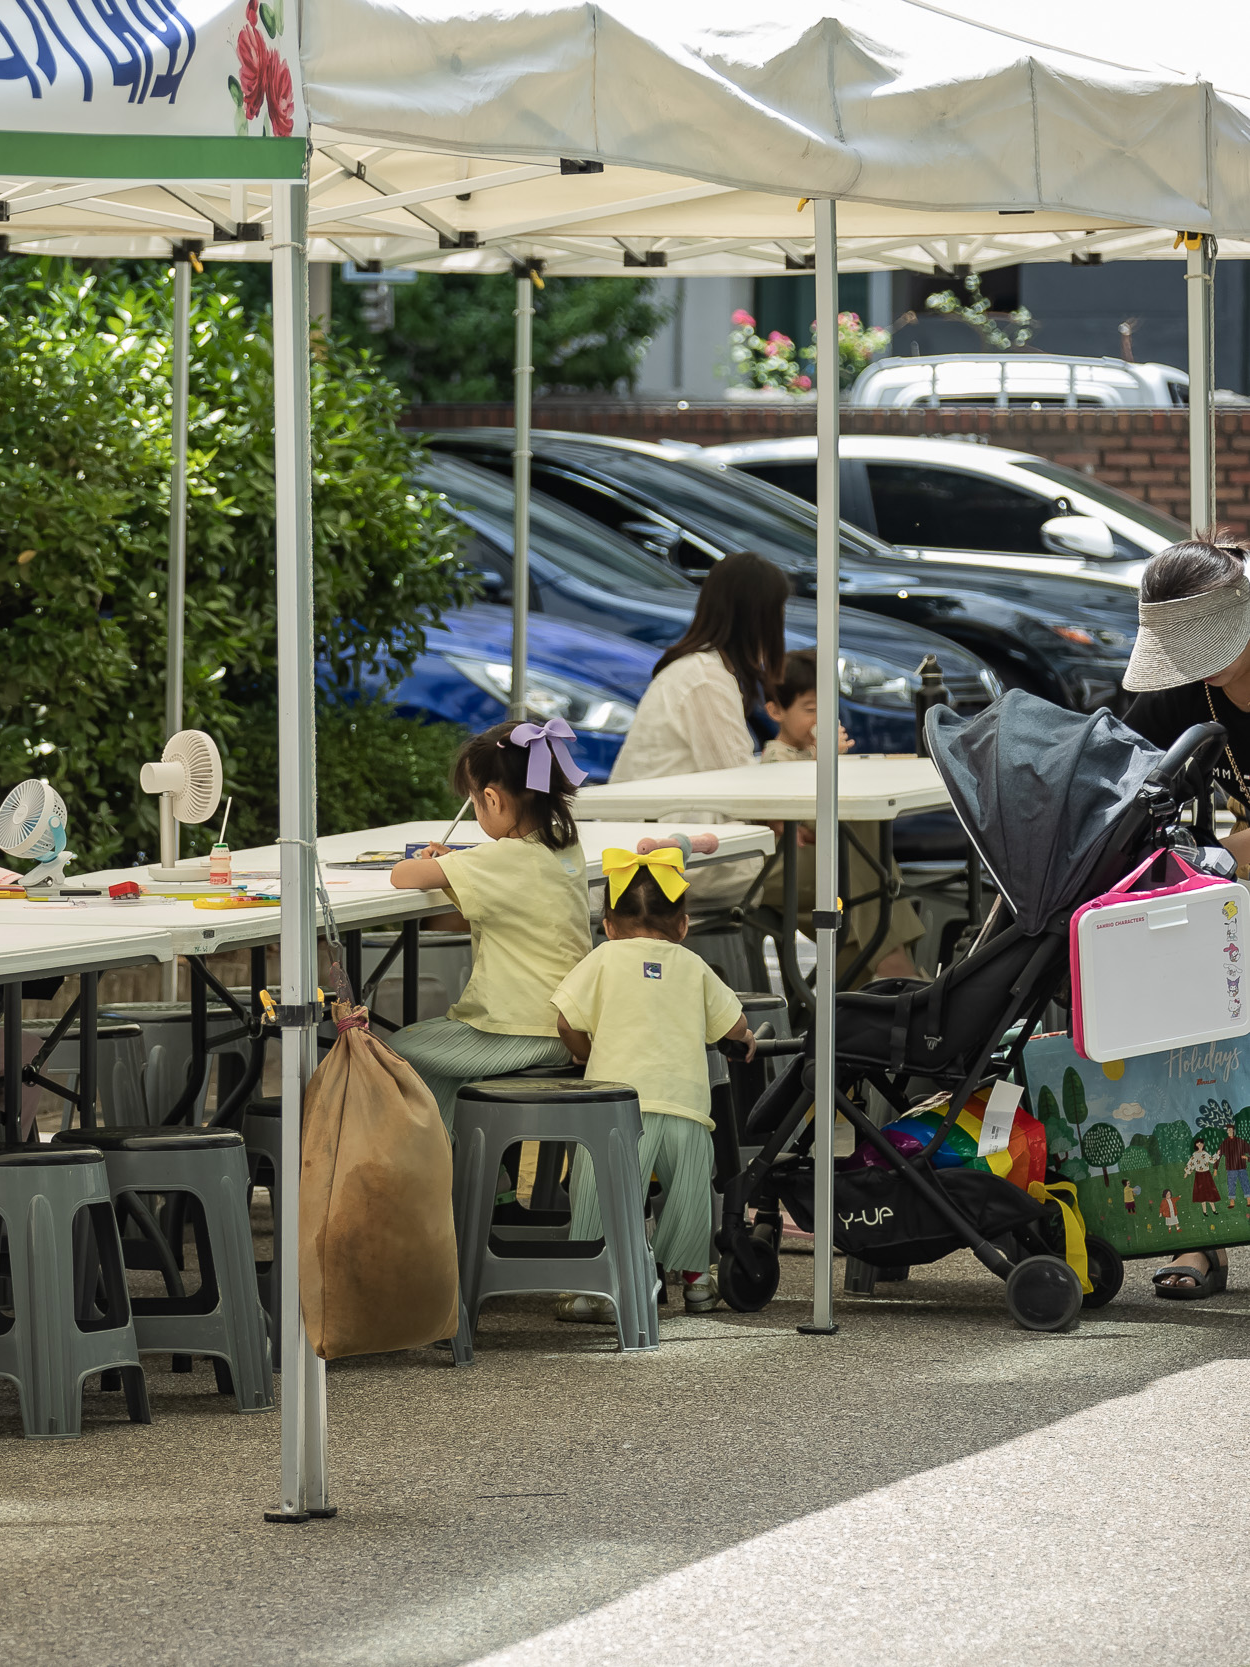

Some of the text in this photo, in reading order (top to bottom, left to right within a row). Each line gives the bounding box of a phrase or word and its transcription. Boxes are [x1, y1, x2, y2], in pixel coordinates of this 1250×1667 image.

[1096, 916, 1145, 930] SANRIO CHARACTERS
[1163, 1041, 1243, 1083] Holidays
[838, 1206, 894, 1230] Y-UP
